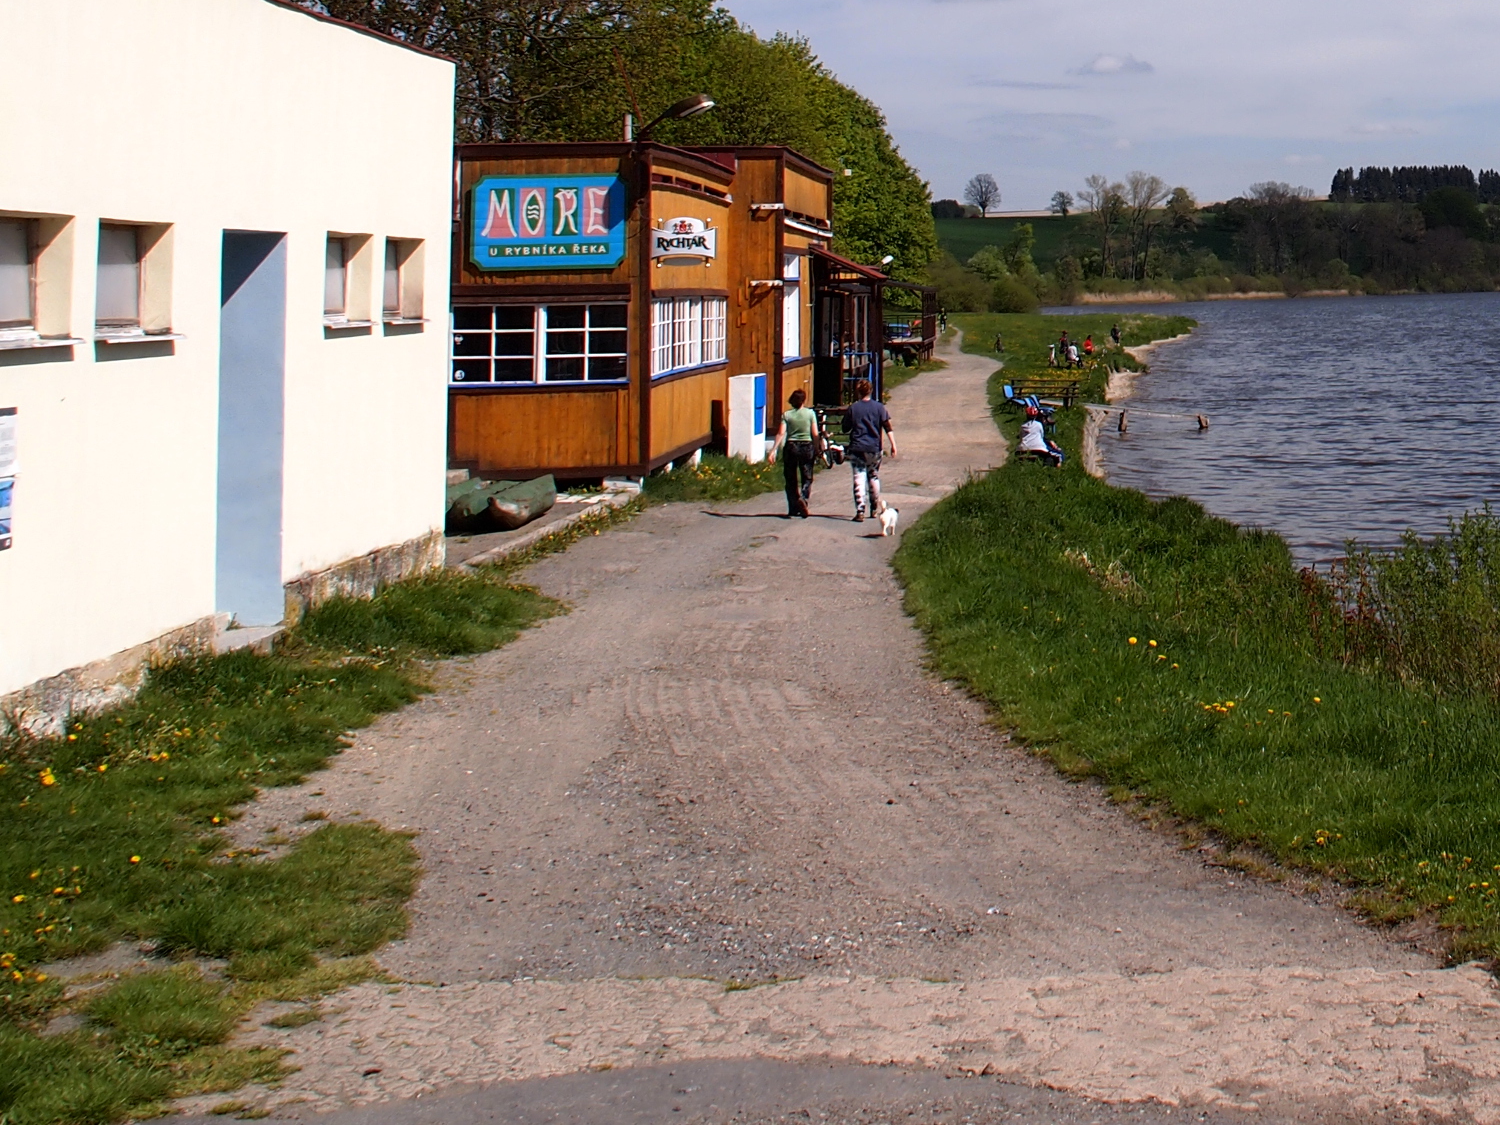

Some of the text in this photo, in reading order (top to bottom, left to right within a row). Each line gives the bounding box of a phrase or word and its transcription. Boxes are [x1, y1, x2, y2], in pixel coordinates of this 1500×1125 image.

[481, 188, 609, 237] MOŘE
[489, 243, 607, 256] U RYBNÍKA ŘEKA
